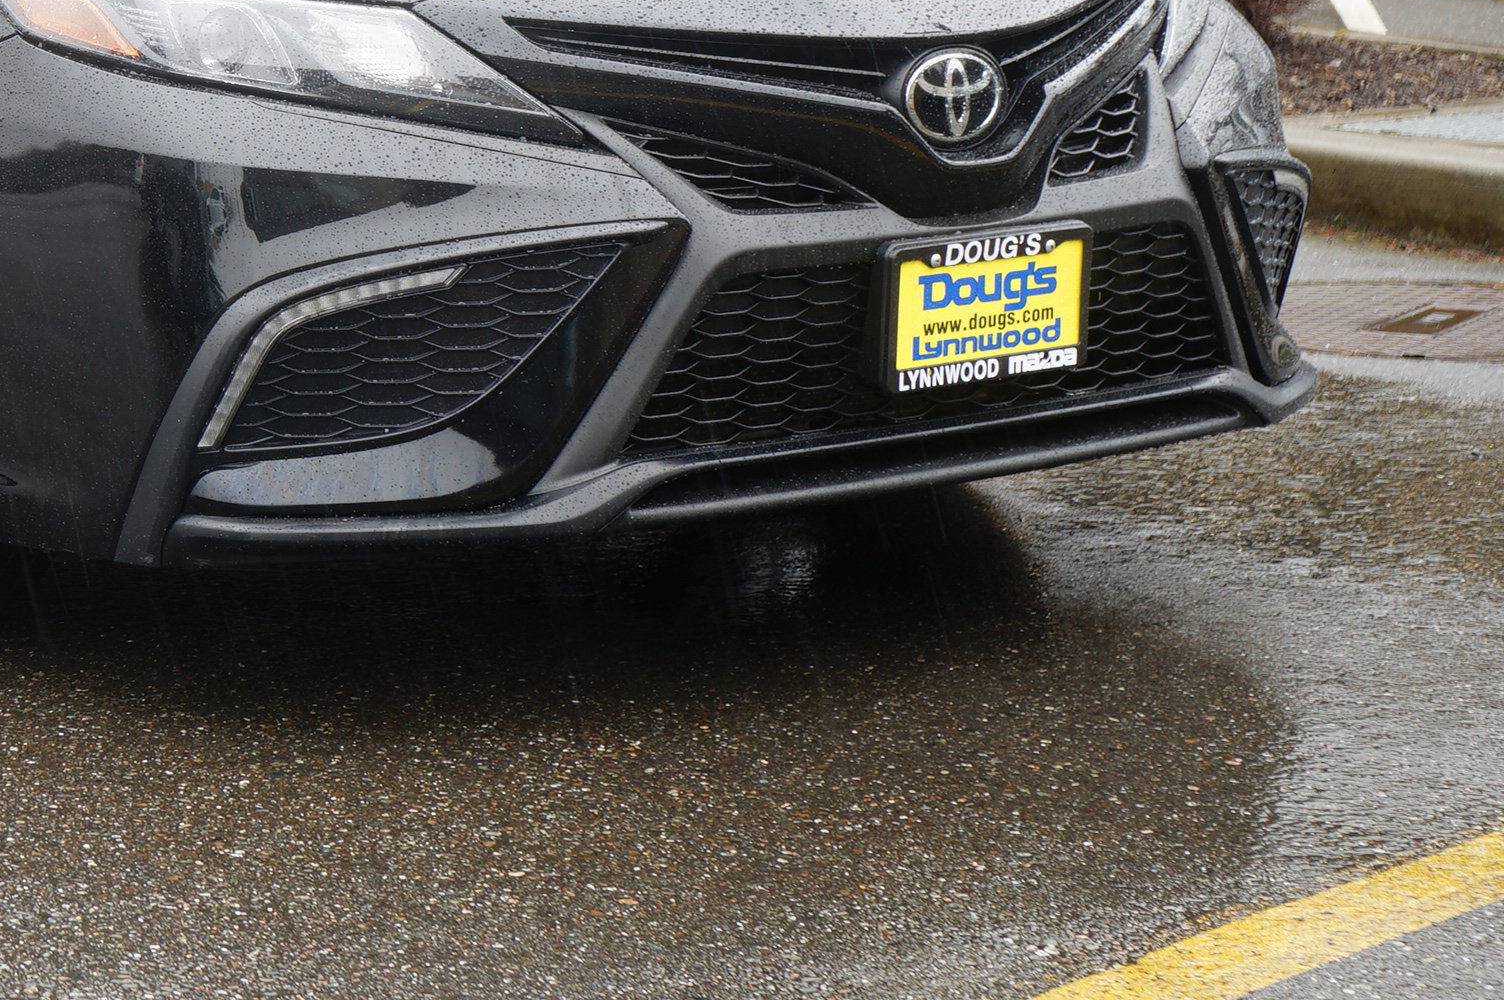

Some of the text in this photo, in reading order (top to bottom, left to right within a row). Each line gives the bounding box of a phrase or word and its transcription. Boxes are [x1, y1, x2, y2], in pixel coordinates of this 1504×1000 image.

[945, 233, 1042, 266] DOUG'S
[923, 306, 1054, 336] www.dougs.com
[912, 317, 1061, 361] Lynnwood
[898, 358, 1000, 392] LYNNWOOD
